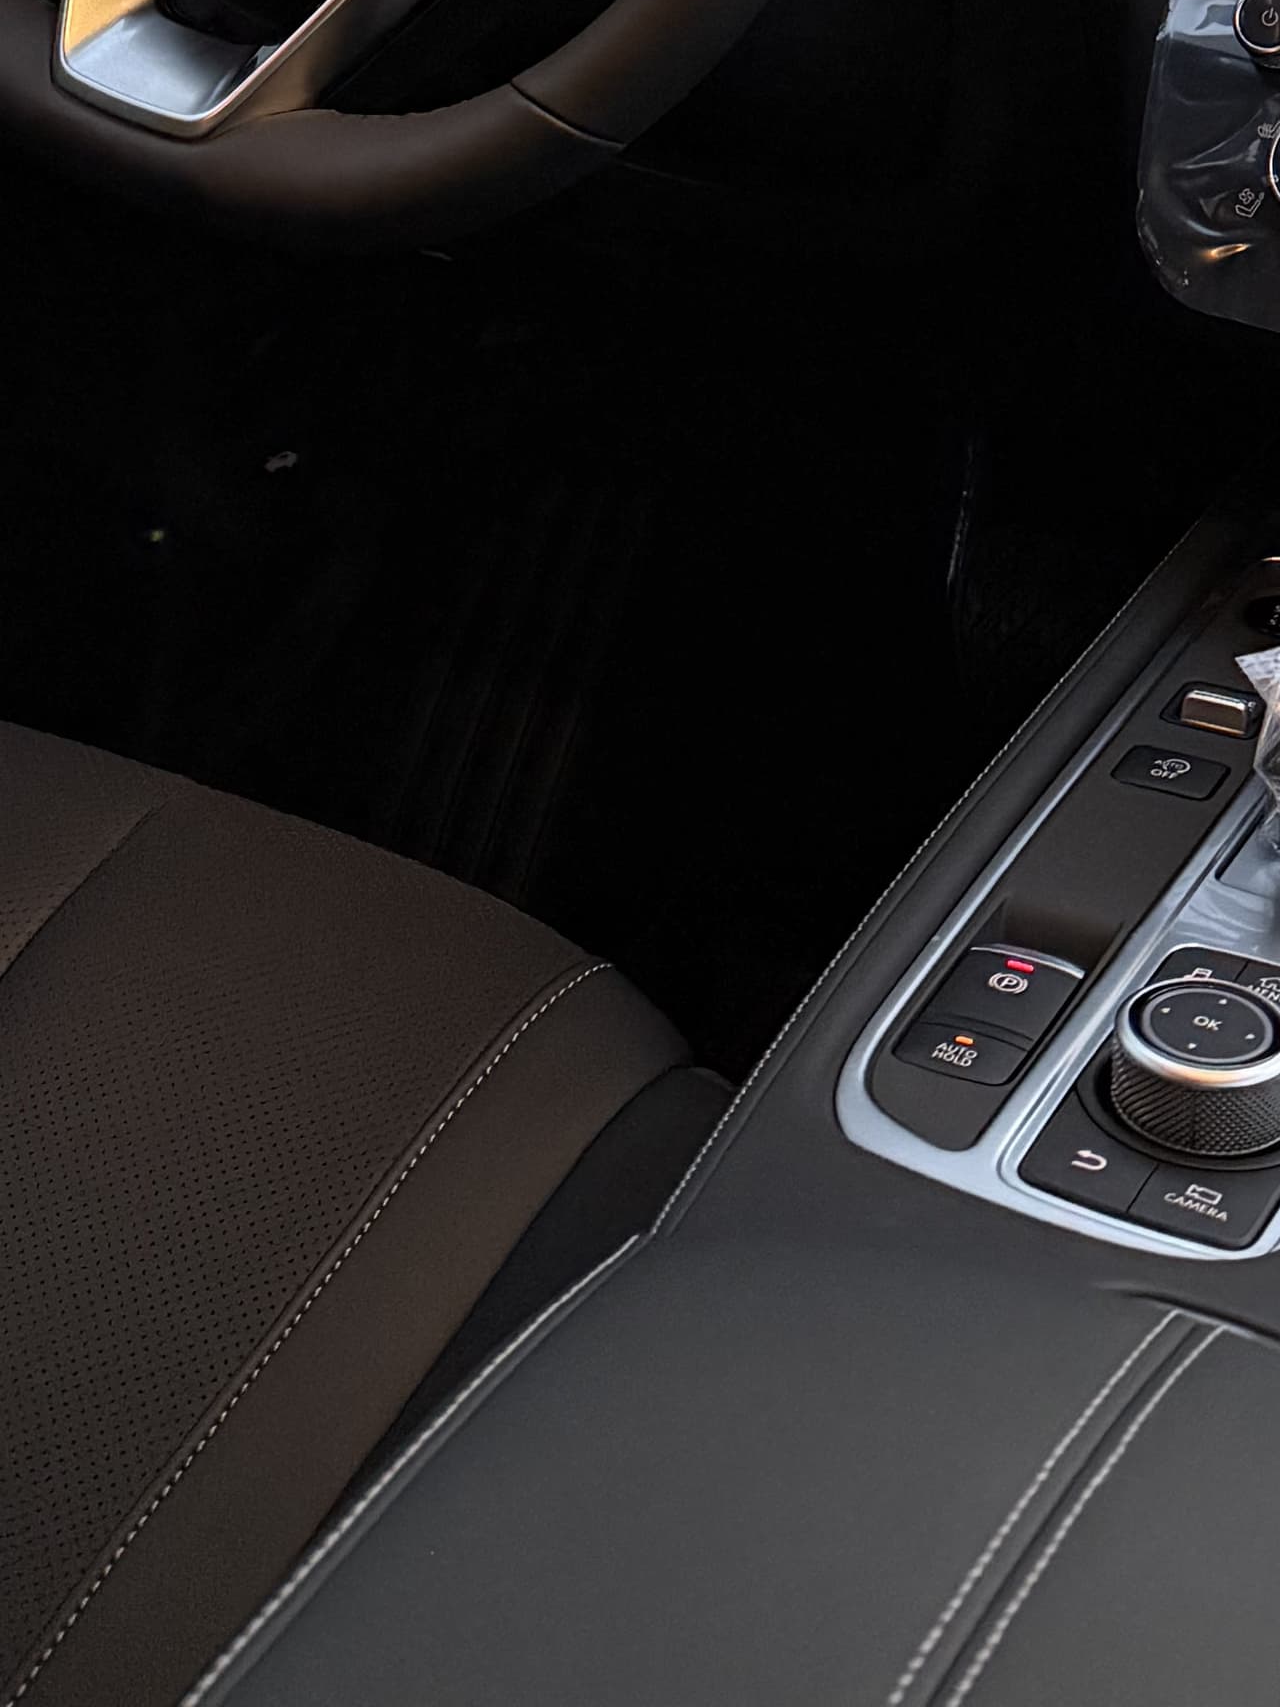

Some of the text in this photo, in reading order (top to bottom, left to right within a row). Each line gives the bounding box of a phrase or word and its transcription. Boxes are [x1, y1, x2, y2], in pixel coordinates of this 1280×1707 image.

[1150, 767, 1179, 780] OFF
[1192, 1015, 1223, 1032] OK
[931, 1049, 973, 1068] HOLD
[936, 1042, 978, 1060] AUTO
[1163, 1191, 1228, 1222] CAMERA
